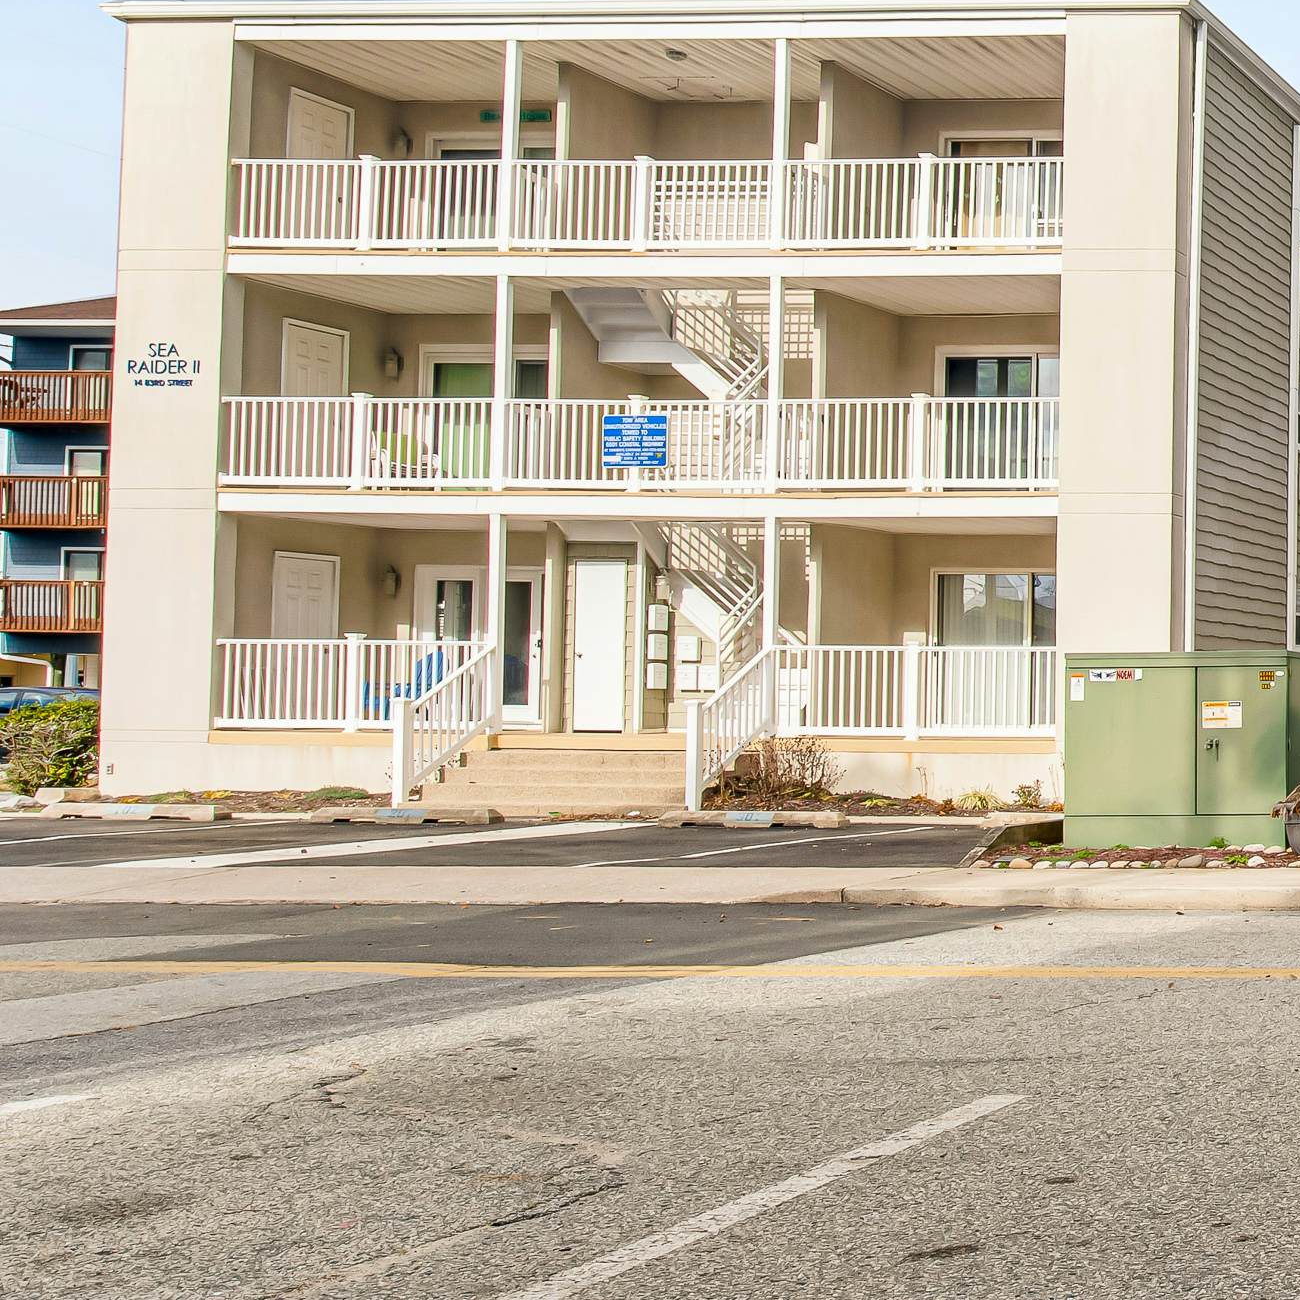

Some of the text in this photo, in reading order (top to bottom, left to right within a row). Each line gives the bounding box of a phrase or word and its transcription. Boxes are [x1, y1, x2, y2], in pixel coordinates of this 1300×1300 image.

[148, 343, 179, 357] SEA
[127, 360, 200, 374] RAIDER II
[167, 379, 193, 387] STREET
